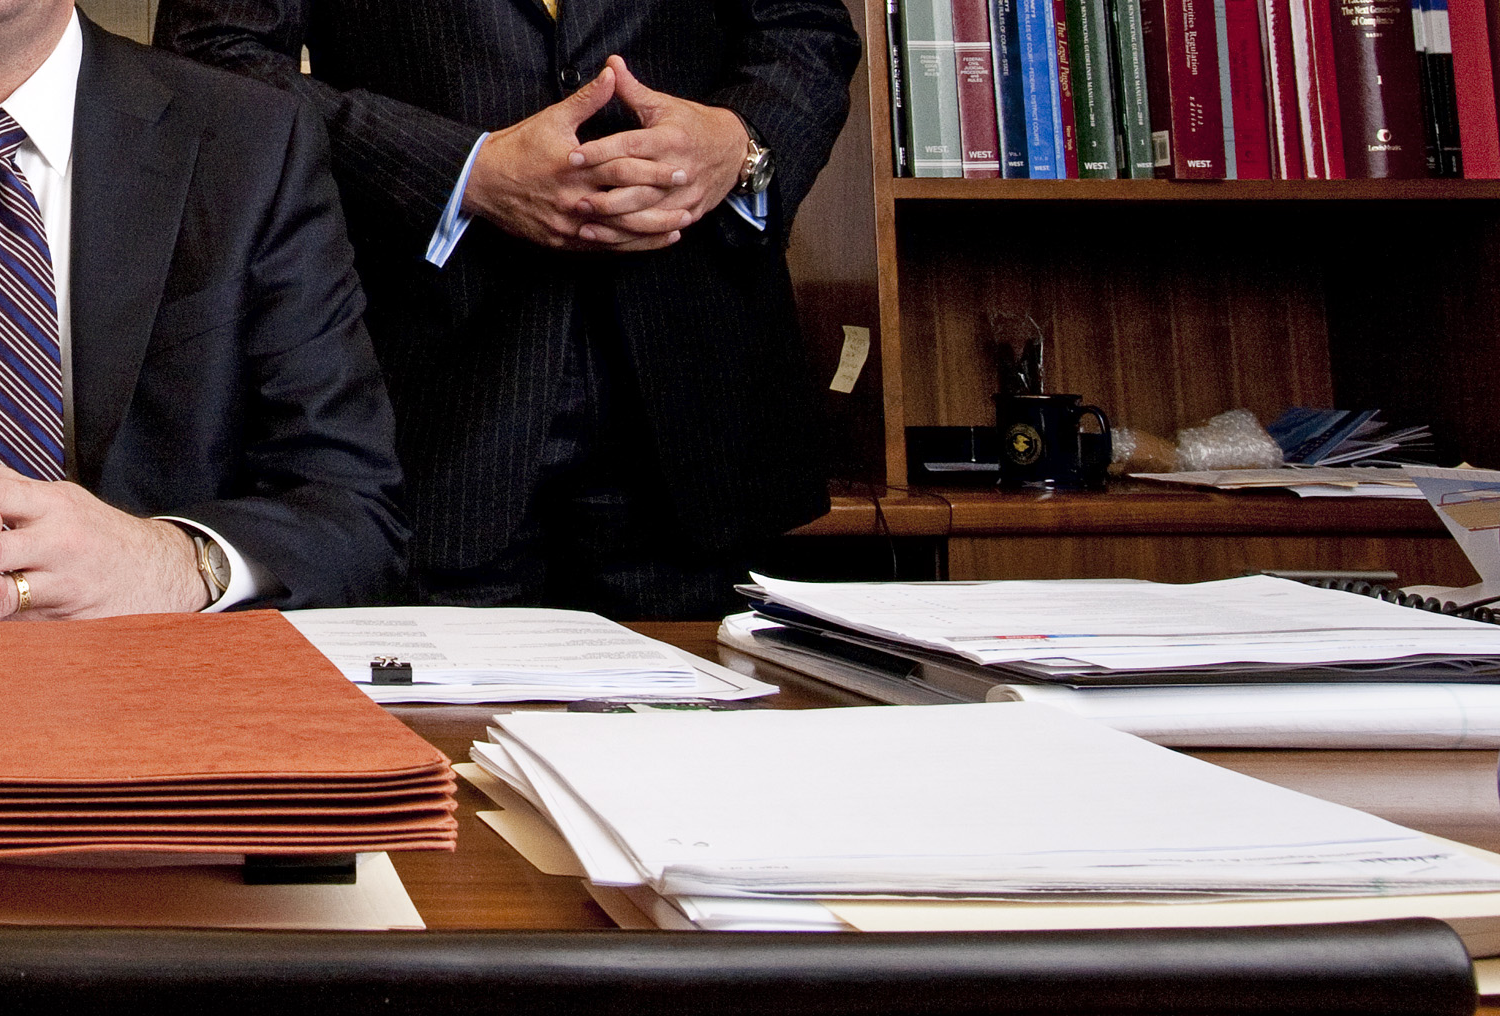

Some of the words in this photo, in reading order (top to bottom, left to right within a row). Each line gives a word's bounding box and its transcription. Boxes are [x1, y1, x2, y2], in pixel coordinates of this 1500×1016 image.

[1341, 7, 1353, 15] The
[1354, 6, 1369, 14] Next
[1351, 17, 1358, 25] of
[1057, 21, 1066, 39] The
[1081, 6, 1090, 43] SENTENCING
[1127, 4, 1137, 42] SENTENCING
[1026, 33, 1032, 41] OF
[1058, 40, 1068, 64] Legal
[1084, 45, 1092, 81] GUIDELINES
[1131, 43, 1140, 79] GUIDELINES
[1188, 31, 1199, 75] Regulation
[1377, 75, 1382, 84] 1
[1030, 95, 1038, 120] DISTRICT
[1032, 122, 1040, 146] COURTS
